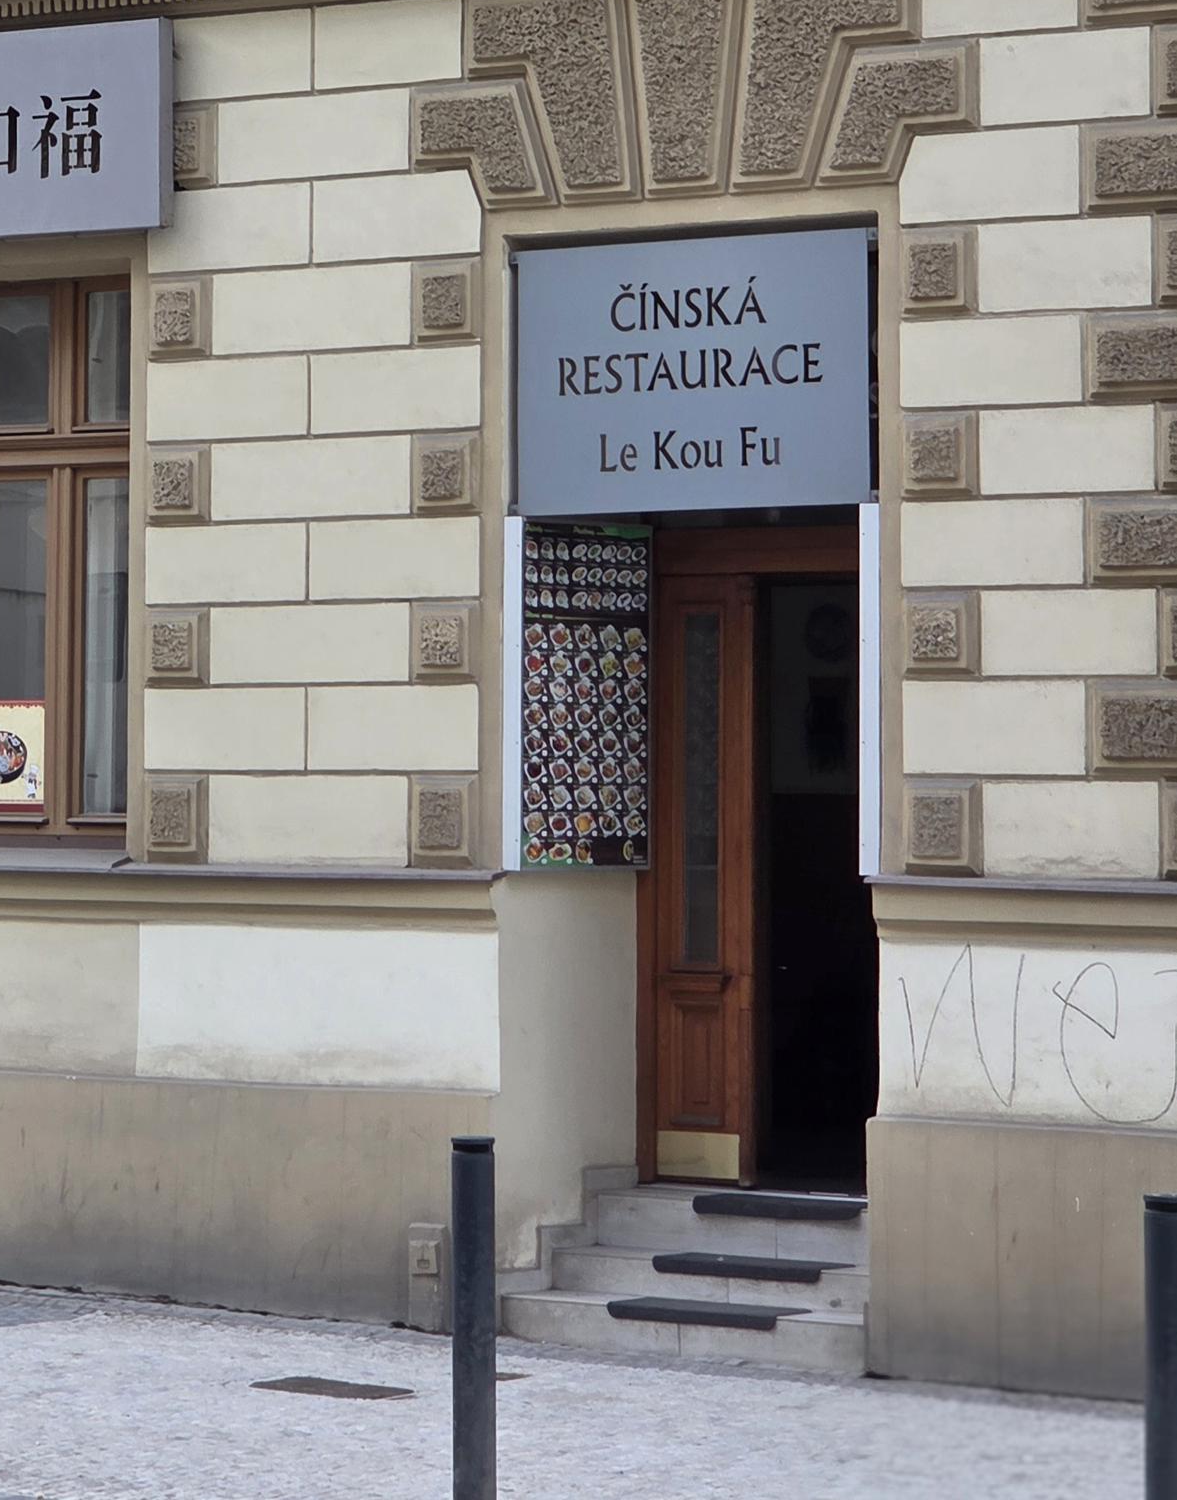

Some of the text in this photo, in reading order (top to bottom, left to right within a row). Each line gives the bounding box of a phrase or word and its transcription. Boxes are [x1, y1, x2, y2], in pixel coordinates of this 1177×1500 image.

[610, 275, 767, 332] ČÍNSKÁ
[557, 342, 824, 397] RESTAURACE
[599, 425, 781, 473] Le Kou Fu
